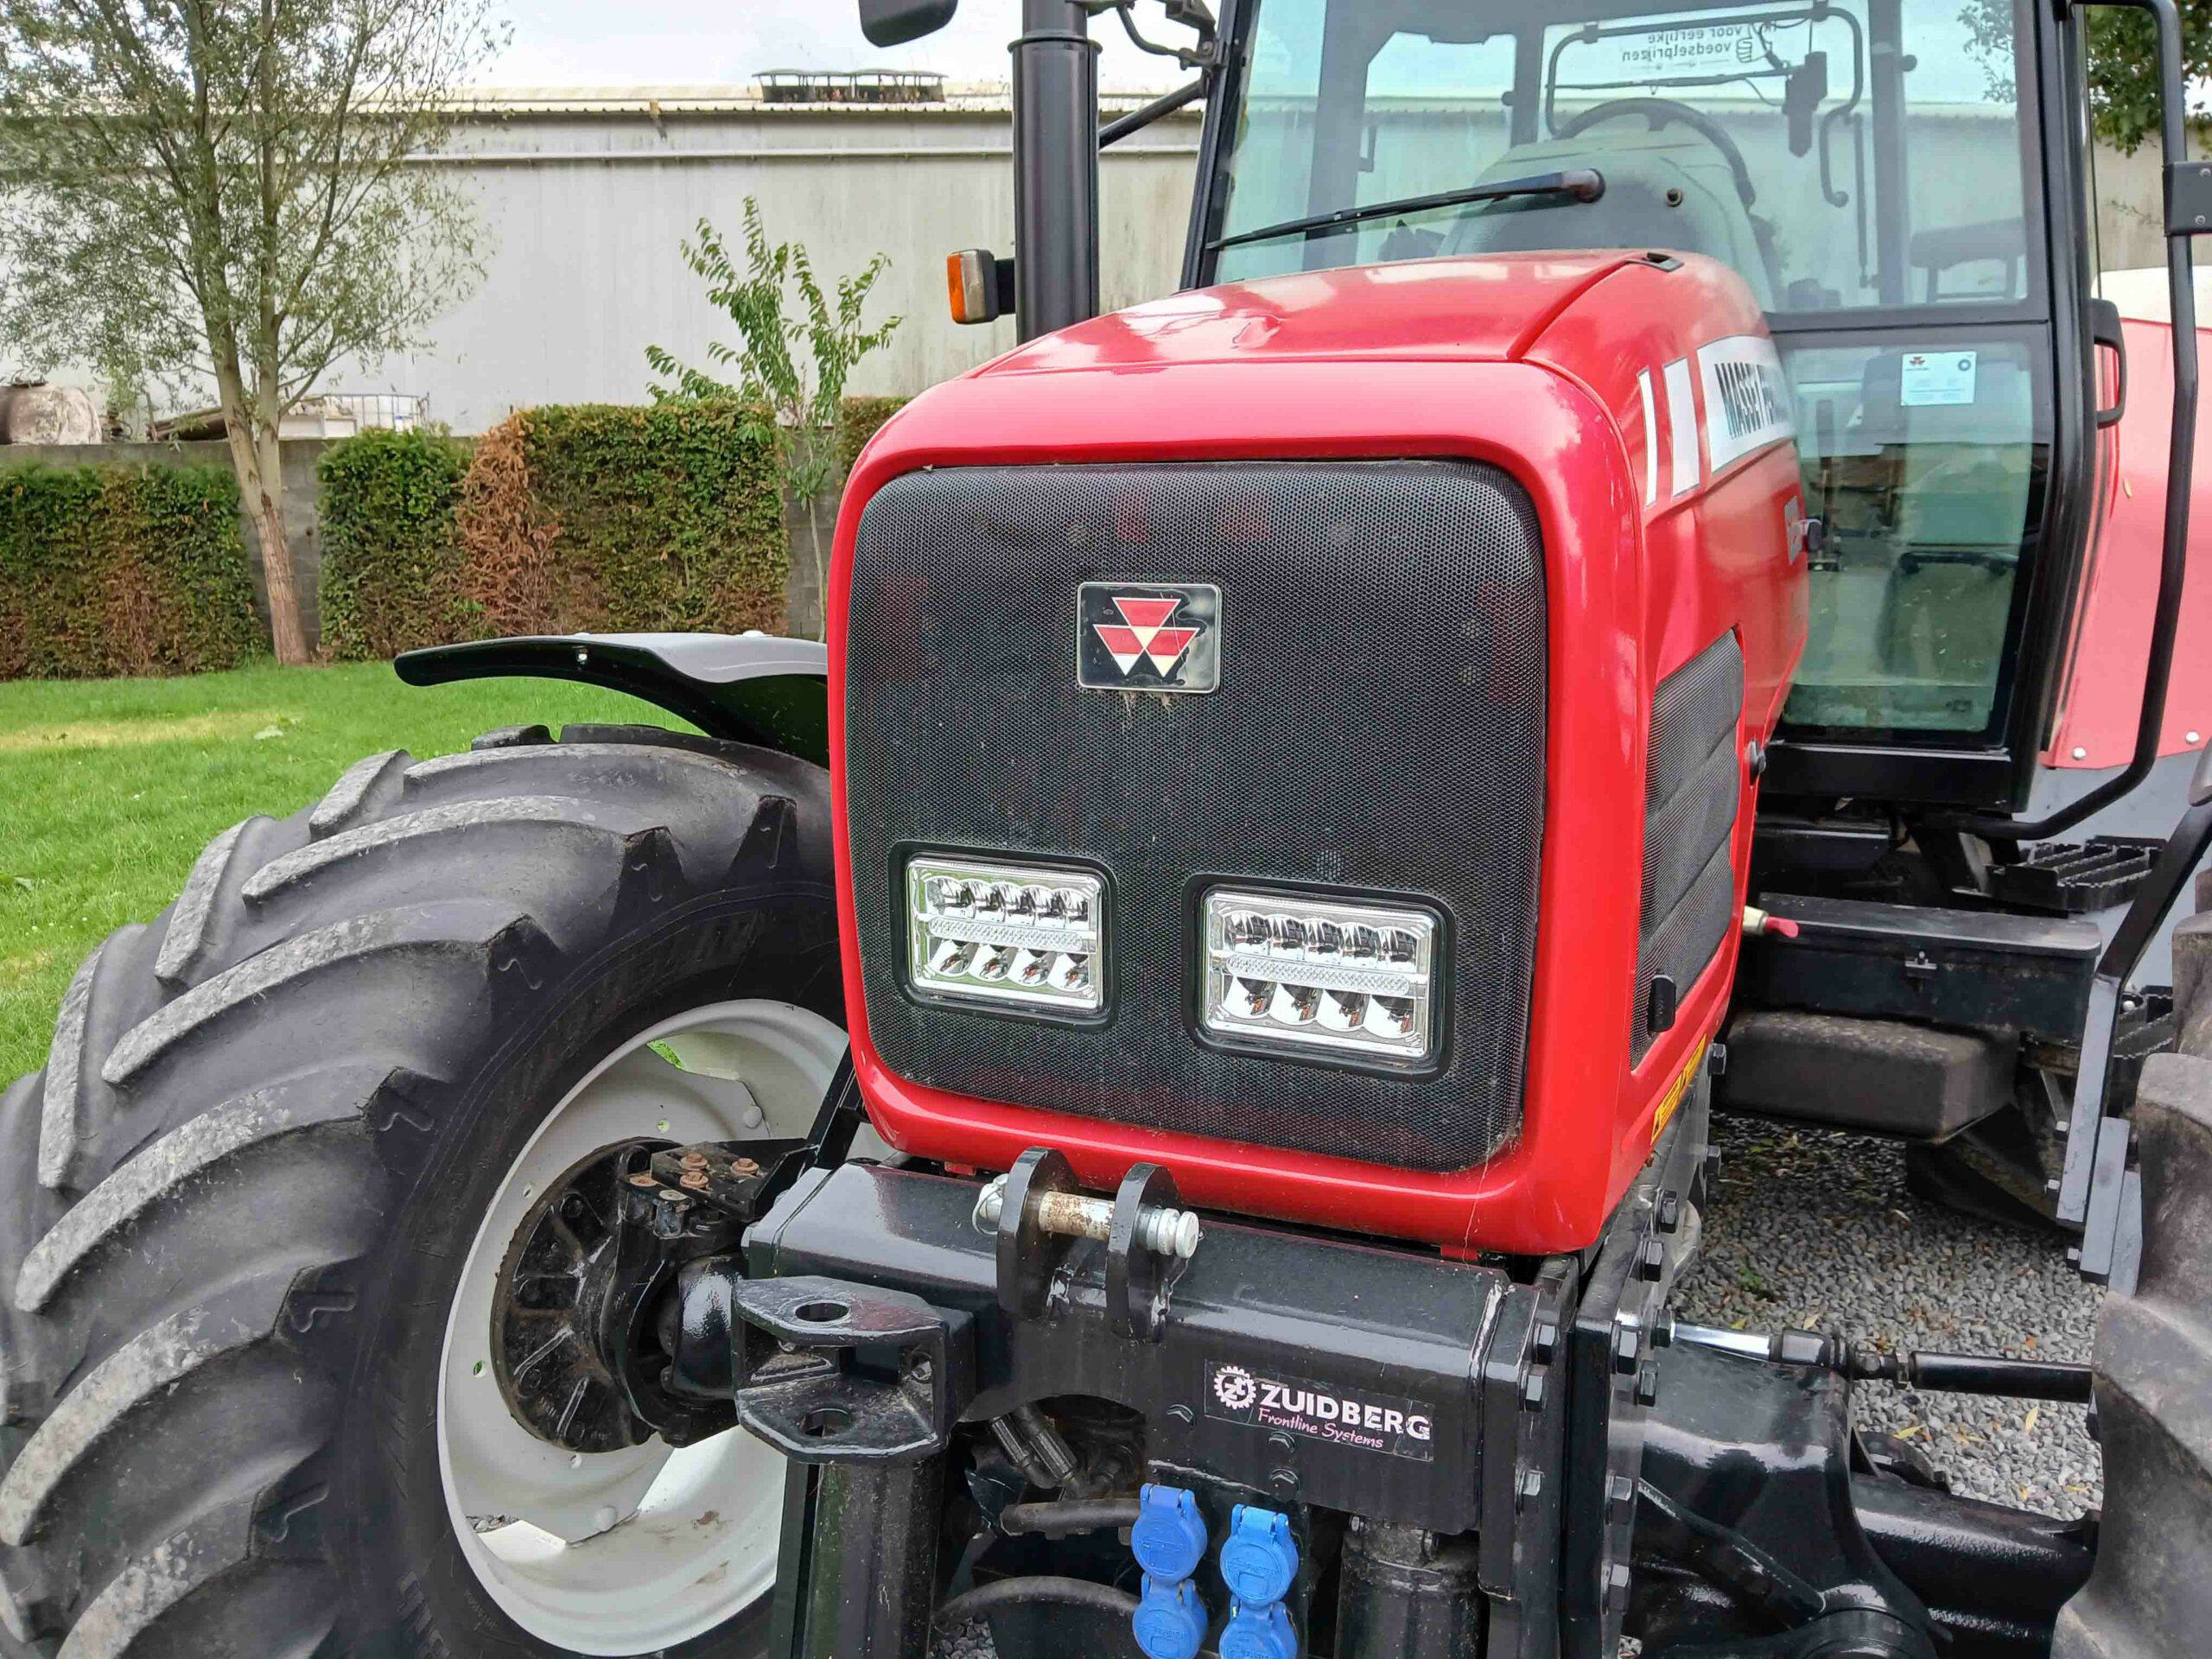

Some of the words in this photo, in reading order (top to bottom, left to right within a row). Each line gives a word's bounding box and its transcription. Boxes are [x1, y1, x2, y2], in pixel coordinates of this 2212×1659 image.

[1258, 1408, 1318, 1434] Frontline
[1321, 1422, 1384, 1448] Systems
[1259, 1384, 1431, 1440] ZUIDBERG
